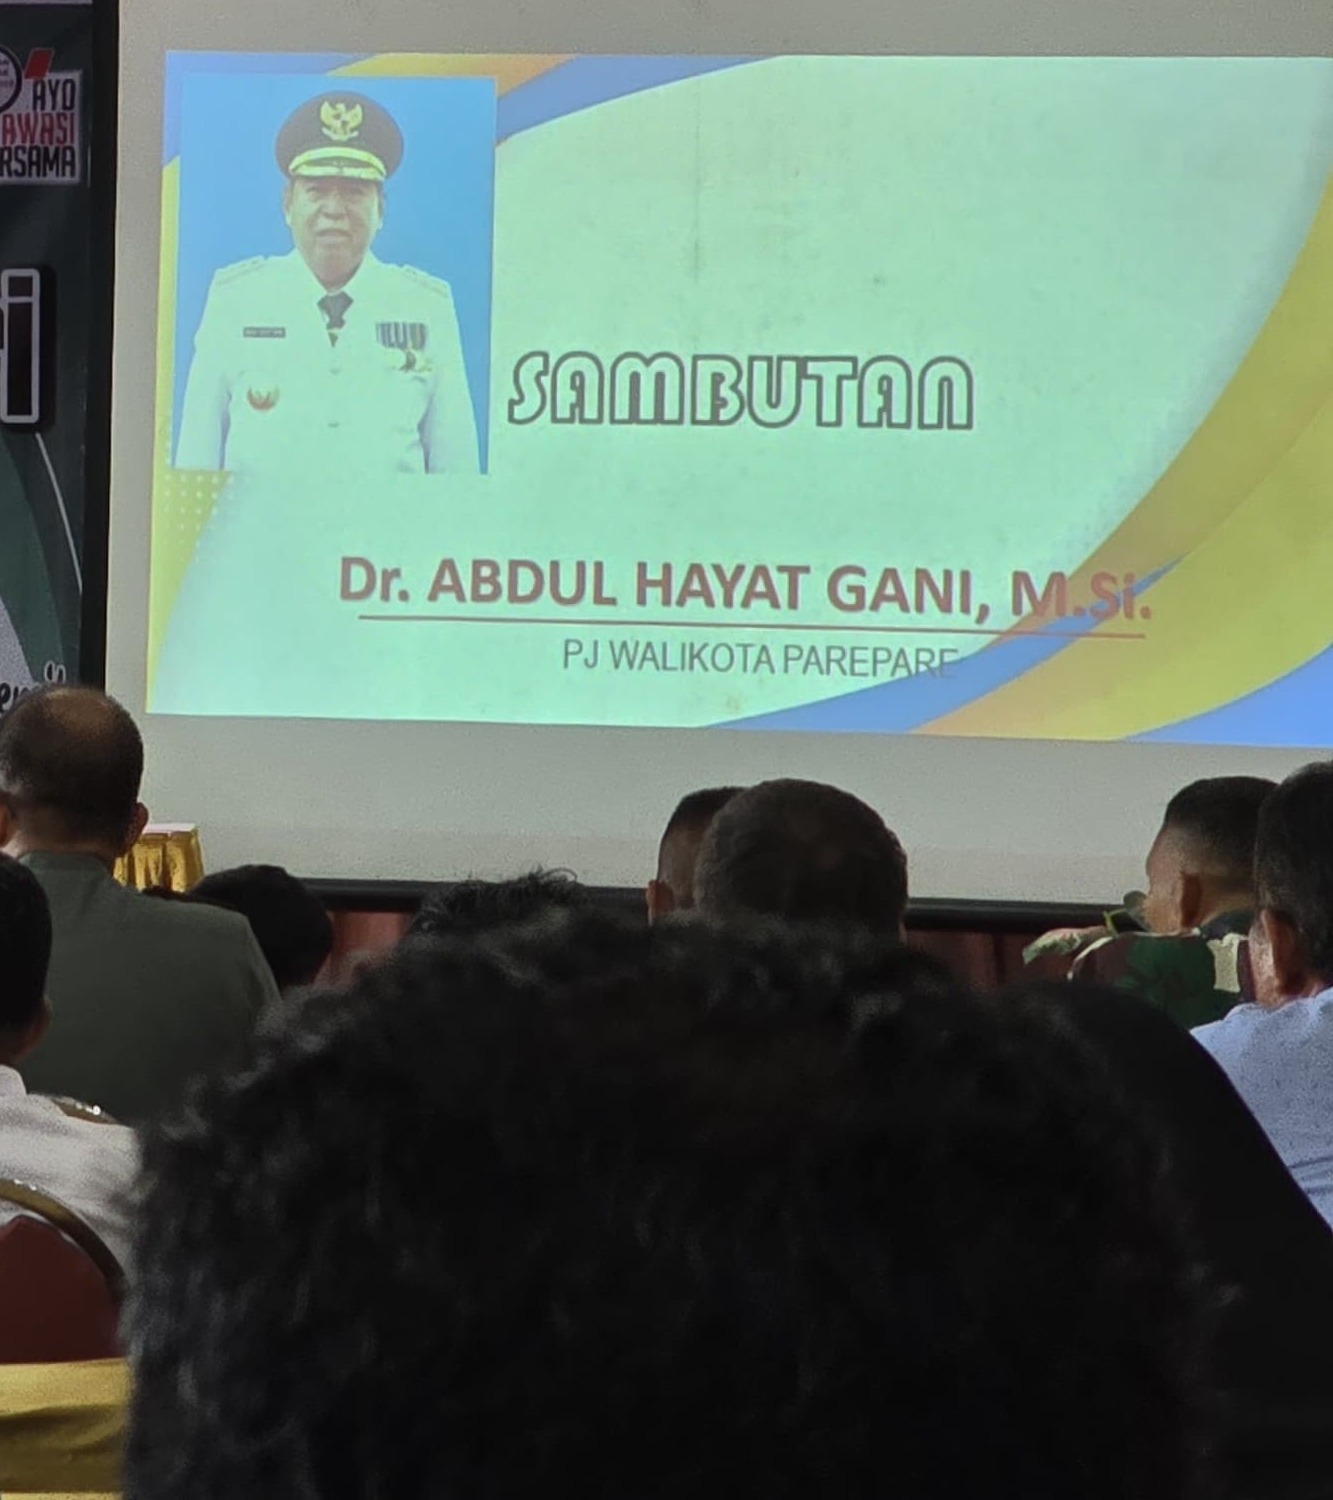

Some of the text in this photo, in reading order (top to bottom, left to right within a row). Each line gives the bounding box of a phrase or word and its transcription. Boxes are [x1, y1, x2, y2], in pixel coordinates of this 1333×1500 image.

[32, 78, 76, 111] AYO
[1, 112, 76, 145] AWASI
[508, 351, 974, 430] SAMBUTAN
[339, 556, 1152, 625] Dr. ABDUL HAYAT GANI, M.Si.
[563, 639, 959, 678] PJ WALIKOTA PAREPARE
